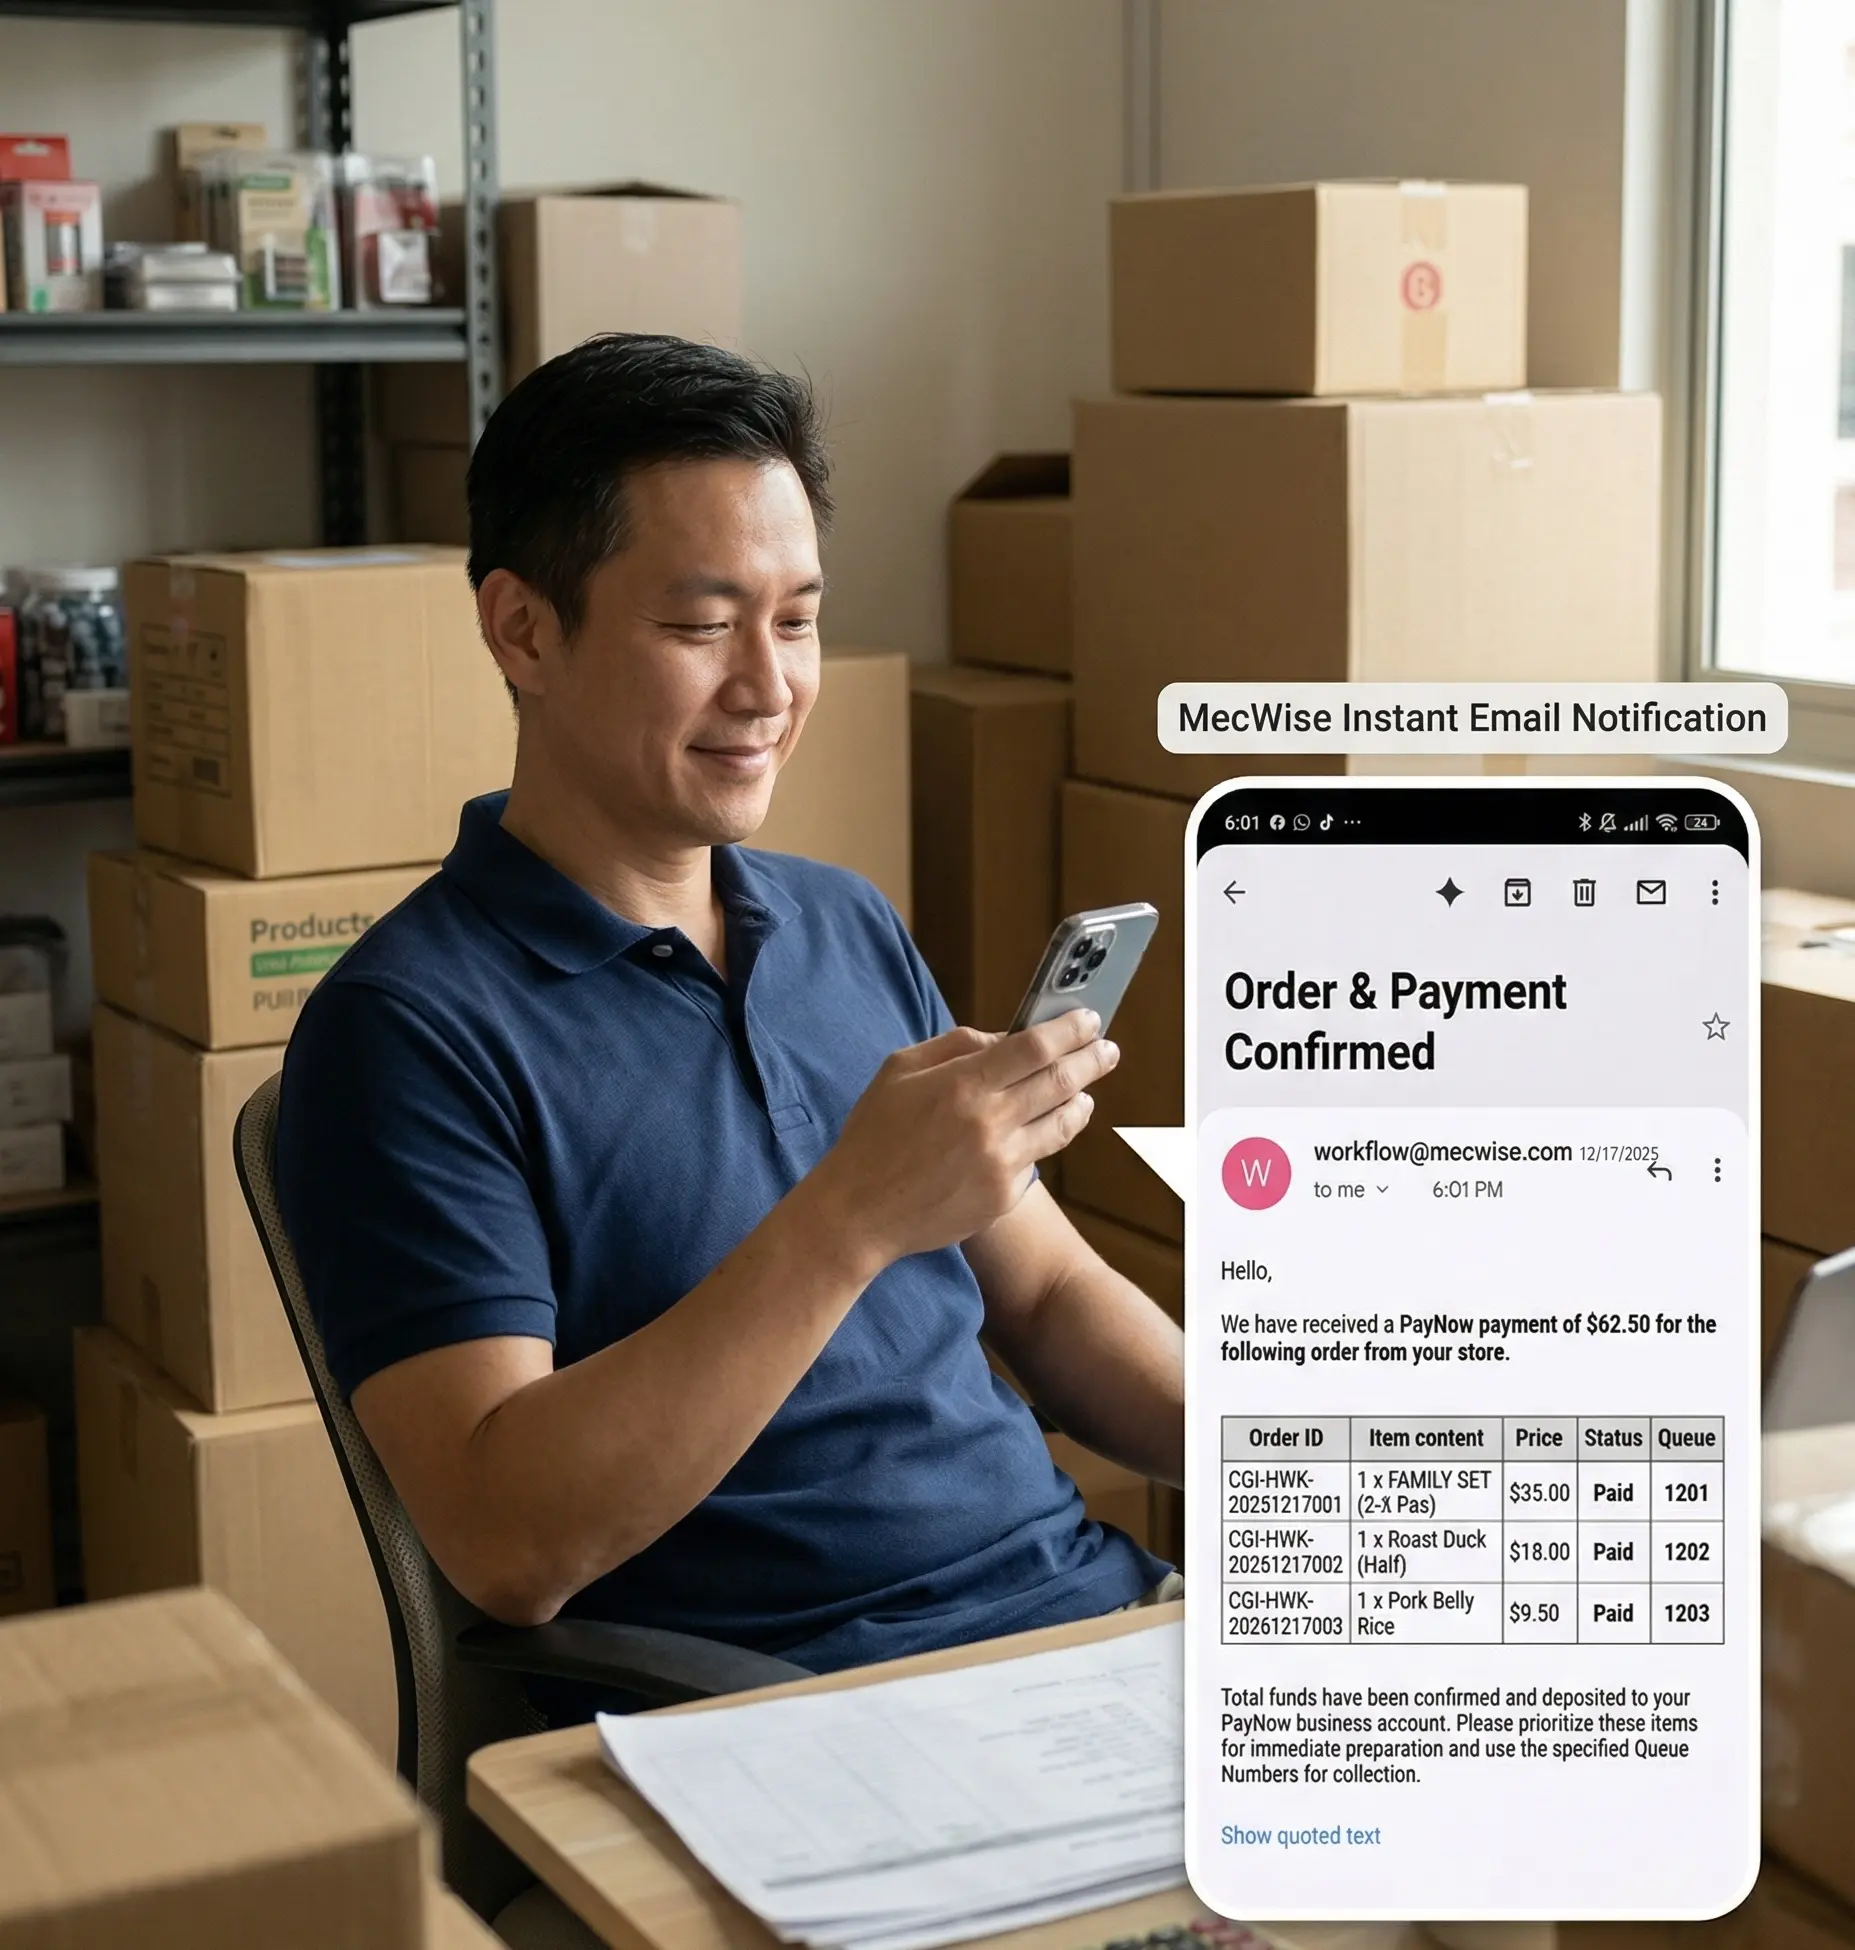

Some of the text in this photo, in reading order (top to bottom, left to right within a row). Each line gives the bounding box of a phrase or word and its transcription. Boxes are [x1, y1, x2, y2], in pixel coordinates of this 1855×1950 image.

[1225, 815, 1258, 830] 6:01
[1694, 817, 1708, 829] 24
[1226, 970, 1567, 1019] Order & Payment
[1226, 1030, 1434, 1070] Confirmed
[1314, 1140, 1658, 1164] workflow@mecwise.com 12/17/2025
[1241, 1159, 1271, 1186] W
[1314, 1182, 1365, 1198] to me
[1433, 1181, 1502, 1198] 6:01 PM
[1222, 1260, 1271, 1283] Hello,
[1221, 1311, 1716, 1338] We have received a PayNow payment of $62.50 for the
[1221, 1341, 1510, 1366] following order from your store.
[1250, 1428, 1323, 1446] Order ID
[1370, 1429, 1484, 1447] Item content
[1516, 1428, 1563, 1446] Price
[1585, 1428, 1642, 1446] Status
[1658, 1428, 1716, 1449] Queue
[1229, 1470, 1313, 1488] CGI-HWK-
[1358, 1470, 1492, 1489] 1 x FAMILY SET
[1510, 1482, 1570, 1504] $35.00
[1594, 1483, 1633, 1501] Paid
[1665, 1483, 1707, 1501] 1201
[1229, 1495, 1340, 1513] 20251217001
[1398, 1494, 1435, 1518] Pas)
[1229, 1530, 1314, 1548] CGI-HWK-
[1358, 1529, 1486, 1548] 1 x Roast Duck
[1510, 1540, 1569, 1563] $18.00
[1594, 1542, 1633, 1561] Paid
[1665, 1542, 1709, 1561] 1202
[1358, 1554, 1406, 1578] (Half)
[1229, 1591, 1314, 1609] CGI-HWK-
[1358, 1590, 1474, 1614] 1 x Pork Belly
[1510, 1602, 1559, 1623] $9.50
[1594, 1603, 1633, 1622] Paid
[1665, 1604, 1709, 1622] 1203
[1229, 1617, 1342, 1635] 20261217003
[1358, 1616, 1394, 1635] Rice
[1221, 1687, 1690, 1711] Total funds have been confirmed and deposited to your
[1222, 1713, 1698, 1736] PayNow business account. Please prioritize these items
[1222, 1738, 1689, 1762] for immediate preparation and use the specified Queue
[1222, 1764, 1420, 1783] Numbers for collection.
[1222, 1825, 1380, 1849] Show quoted text
